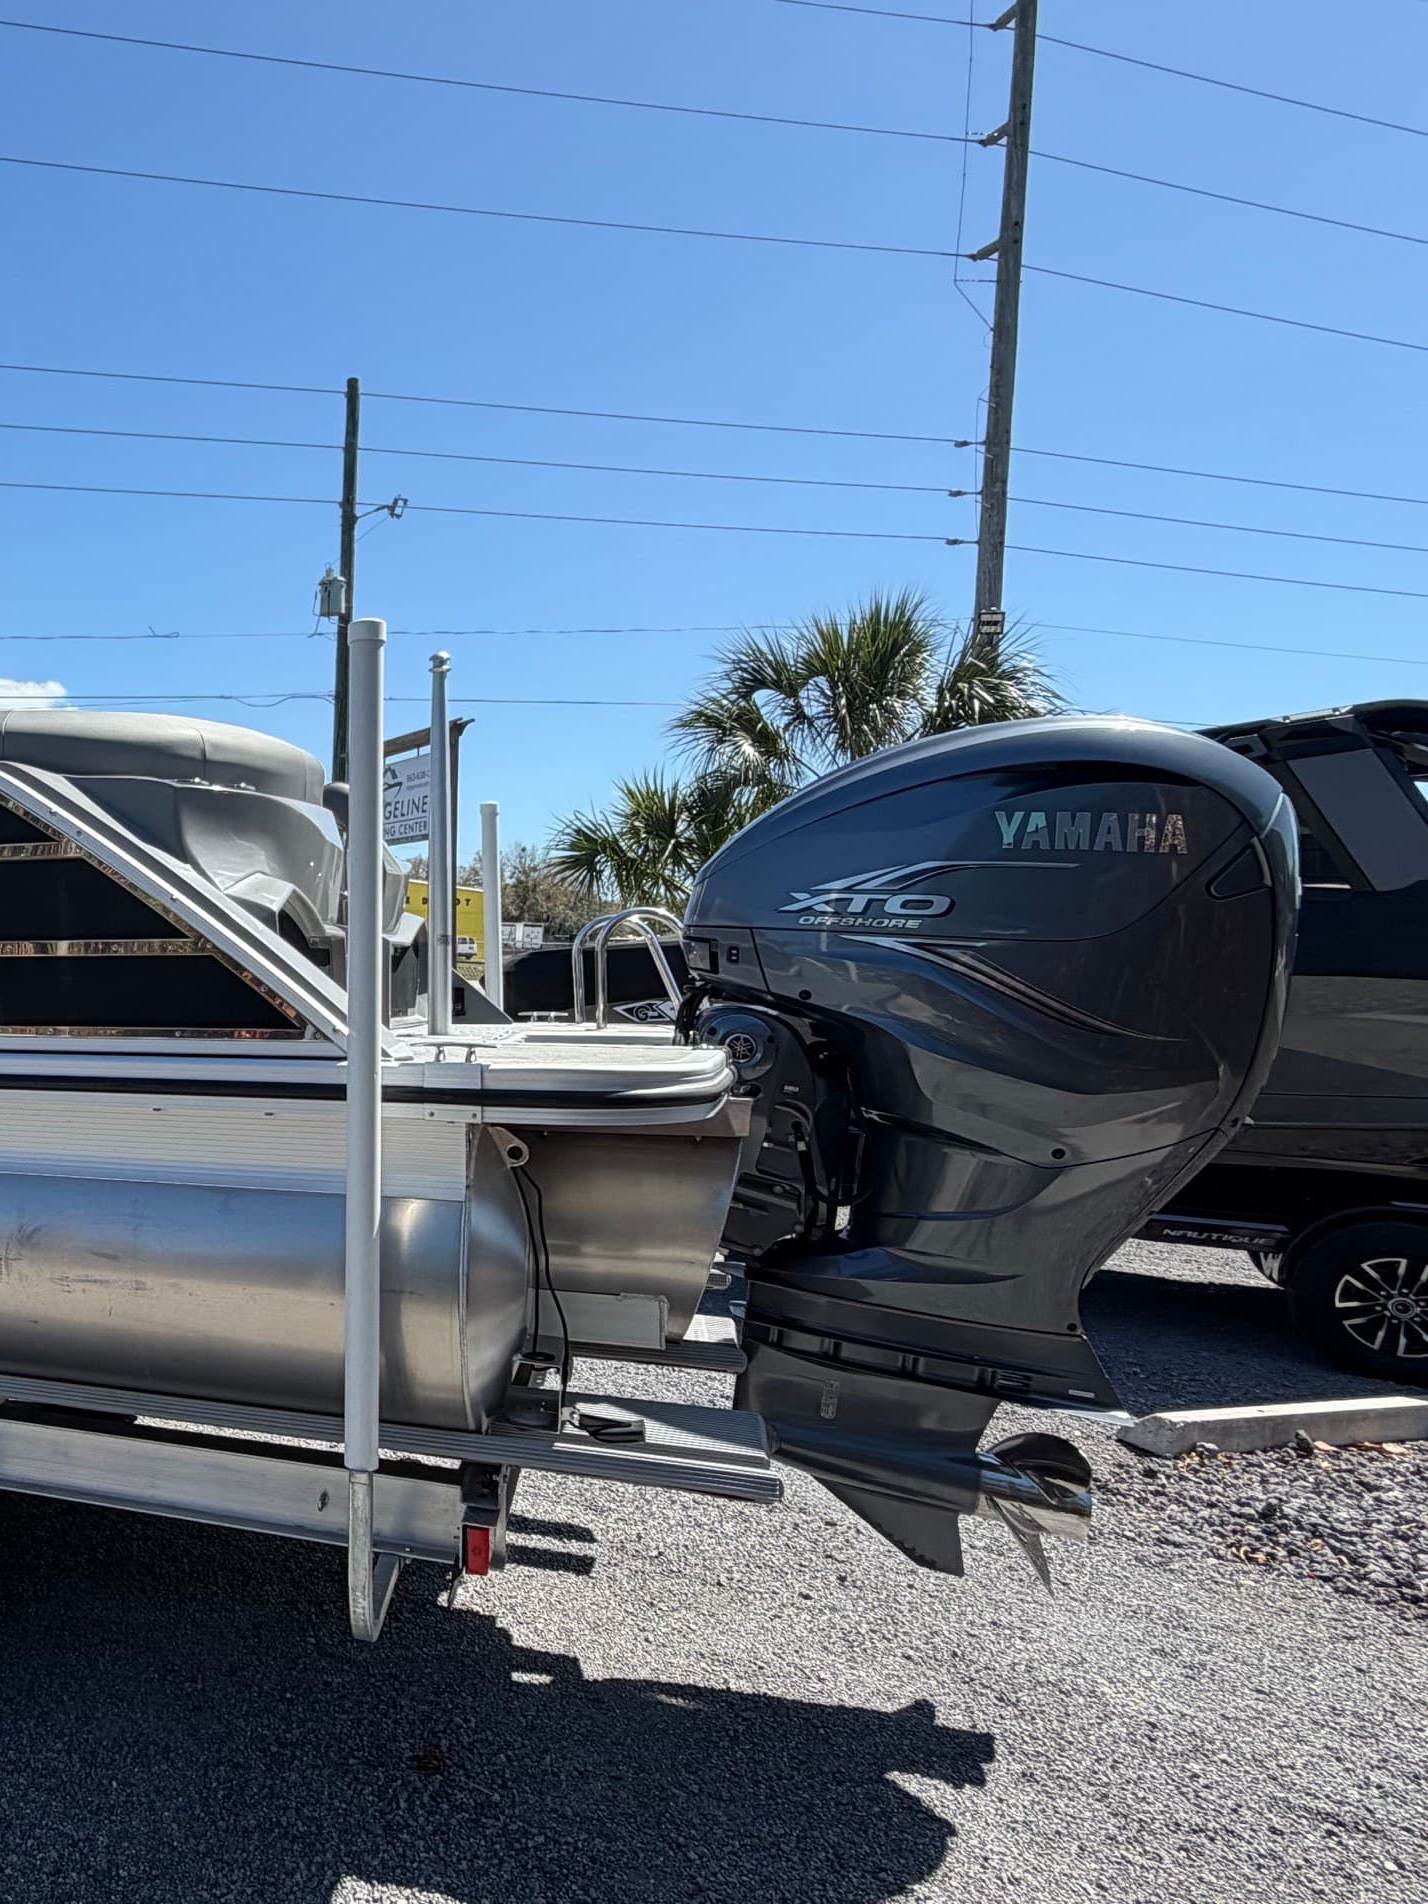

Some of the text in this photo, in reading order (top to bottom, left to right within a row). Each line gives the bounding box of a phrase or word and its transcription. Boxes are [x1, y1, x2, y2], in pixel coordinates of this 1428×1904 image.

[398, 820, 428, 836] CENTER
[994, 810, 1189, 855] YAMAHA
[777, 892, 956, 918] XTO
[798, 915, 923, 929] OFFSHORE
[1162, 1228, 1278, 1246] NAUTIQUE
